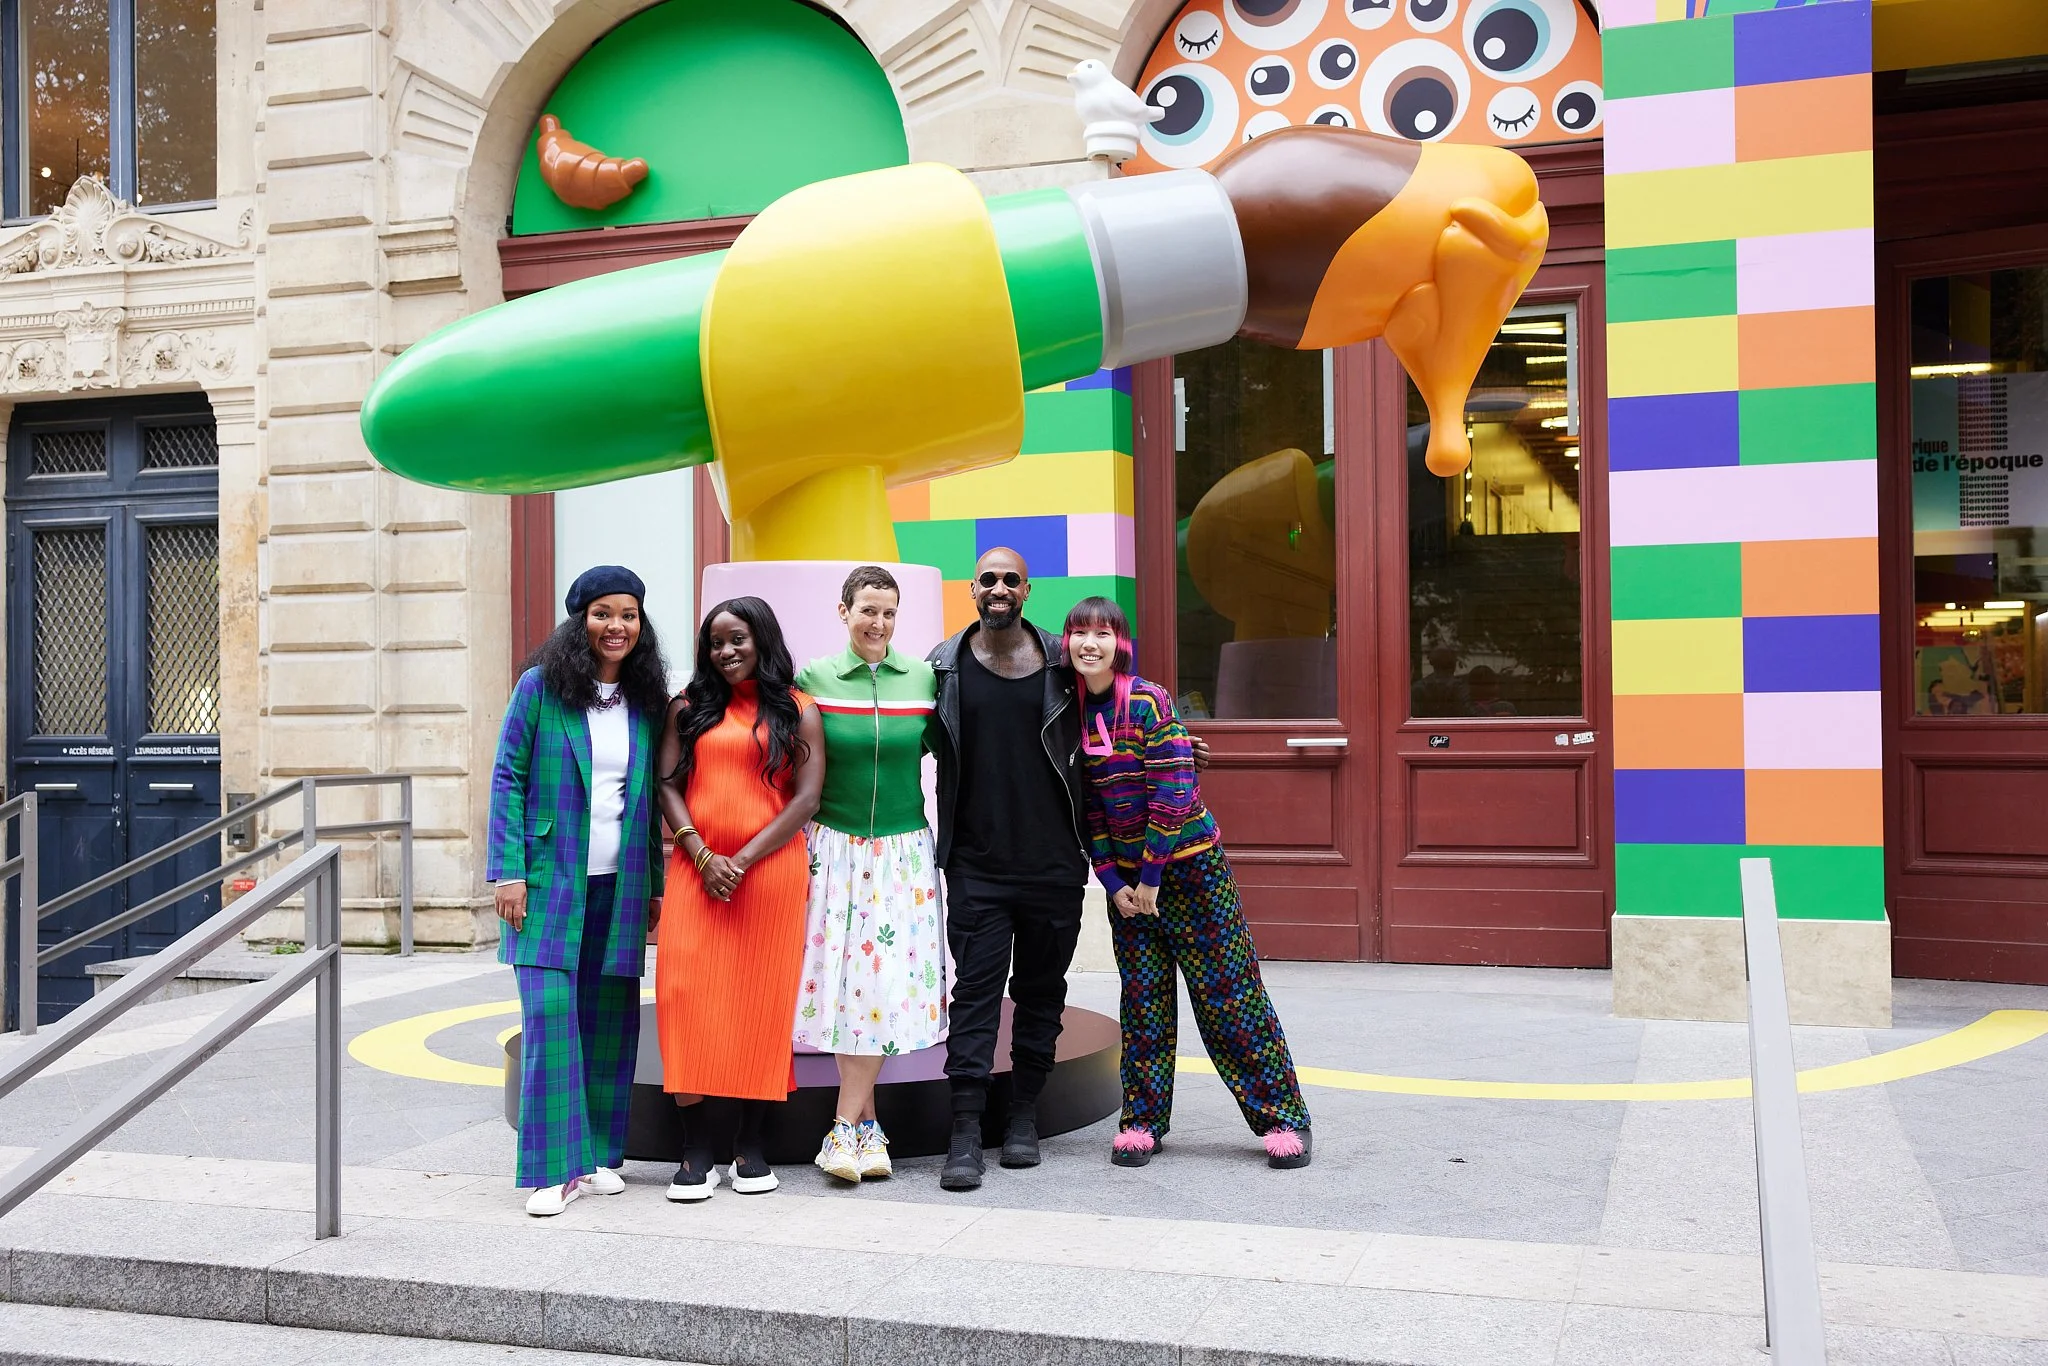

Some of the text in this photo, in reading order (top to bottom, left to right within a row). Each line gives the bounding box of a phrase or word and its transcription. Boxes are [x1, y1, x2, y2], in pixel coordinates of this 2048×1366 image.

[1913, 454, 2044, 473] de l'époque
[69, 746, 114, 755] ACCÈS RÉSERVÉ
[135, 747, 171, 755] LIVRAISONS
[192, 747, 219, 755] LYRIQUE
